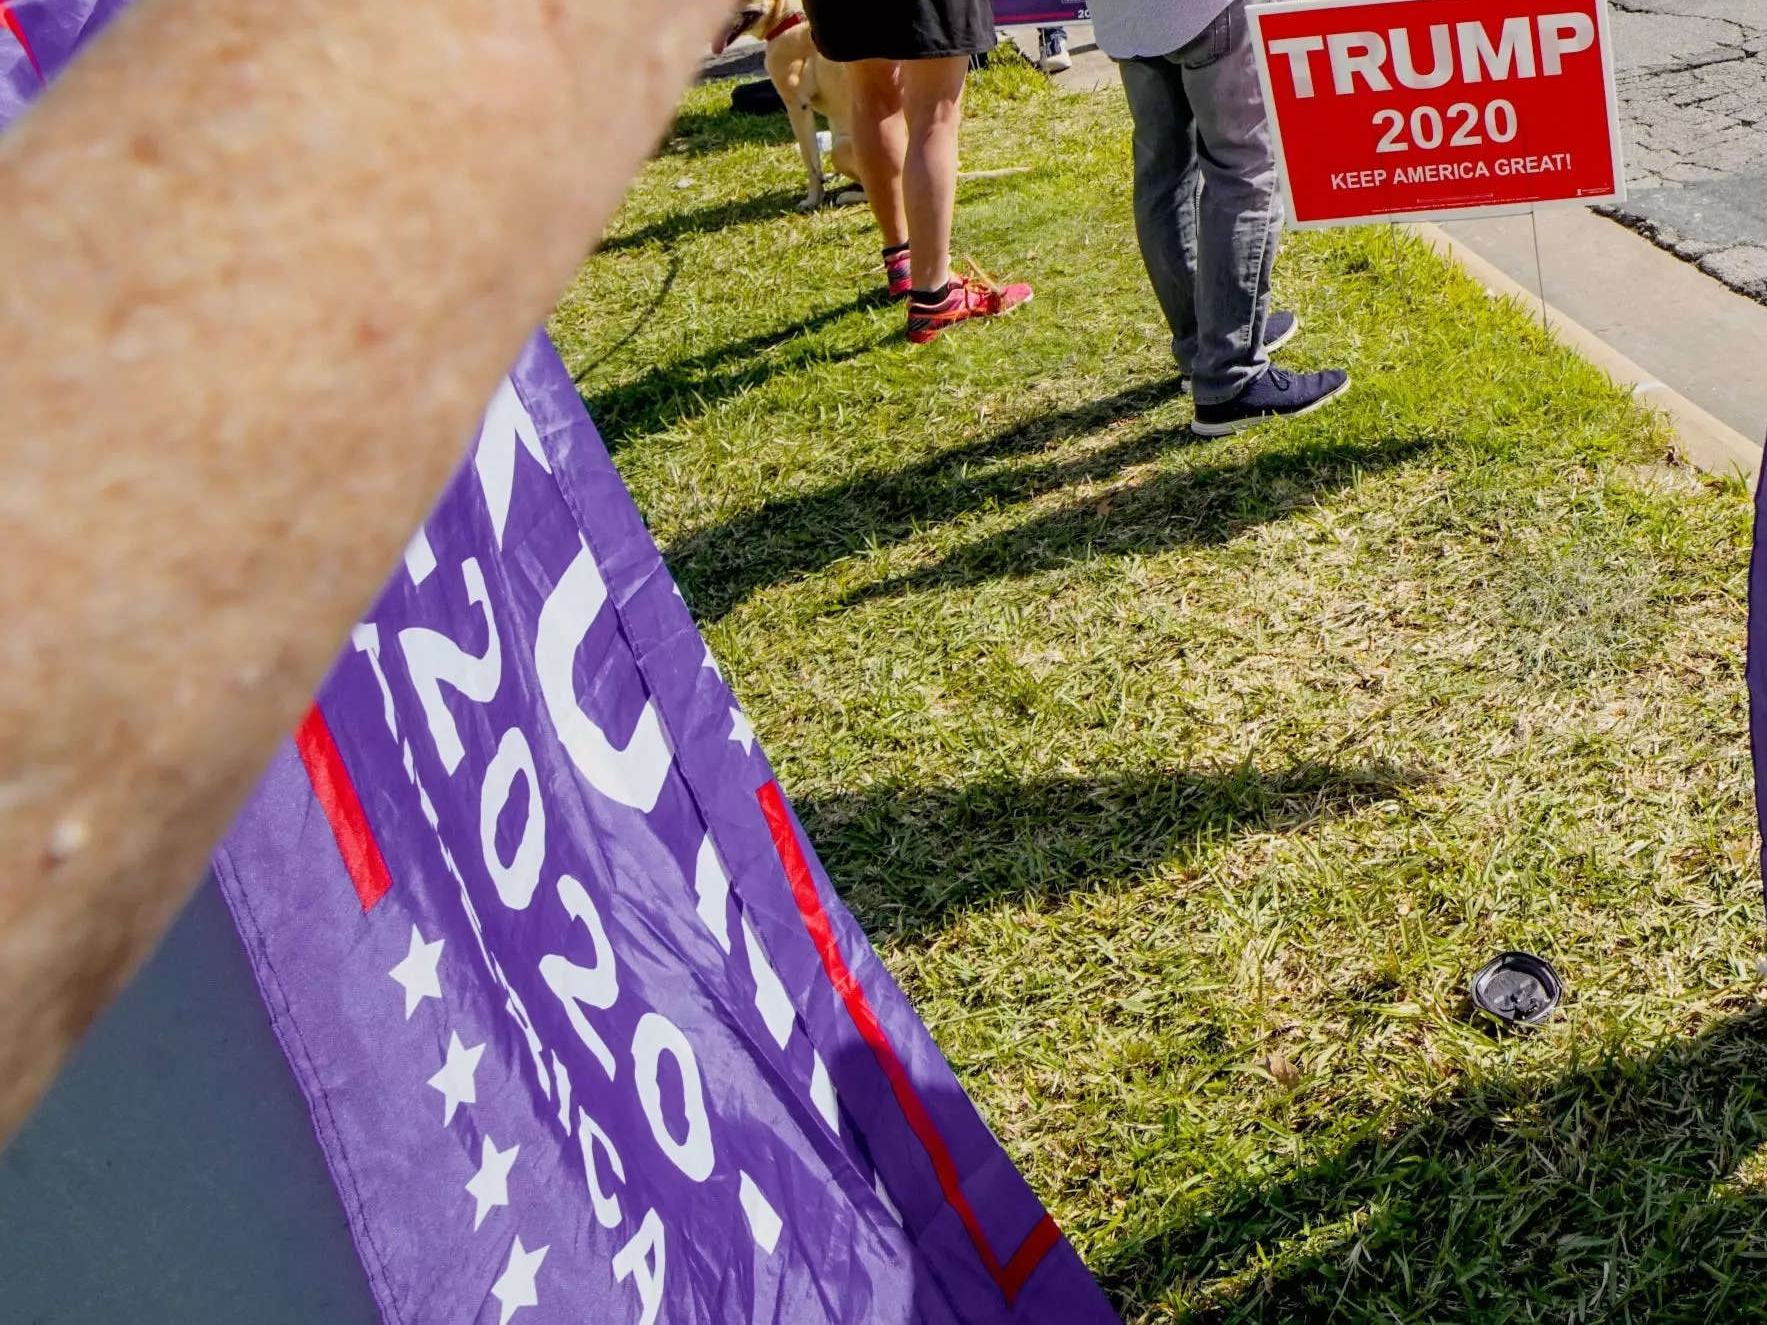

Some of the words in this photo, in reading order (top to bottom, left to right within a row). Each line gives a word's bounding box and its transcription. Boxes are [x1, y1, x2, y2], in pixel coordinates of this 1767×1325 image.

[1268, 11, 1595, 99] TRUMP
[1371, 98, 1518, 153] 2020
[1330, 169, 1387, 191] KEEP
[1392, 160, 1490, 186] AMERICA
[1494, 153, 1572, 177] GREAT!
